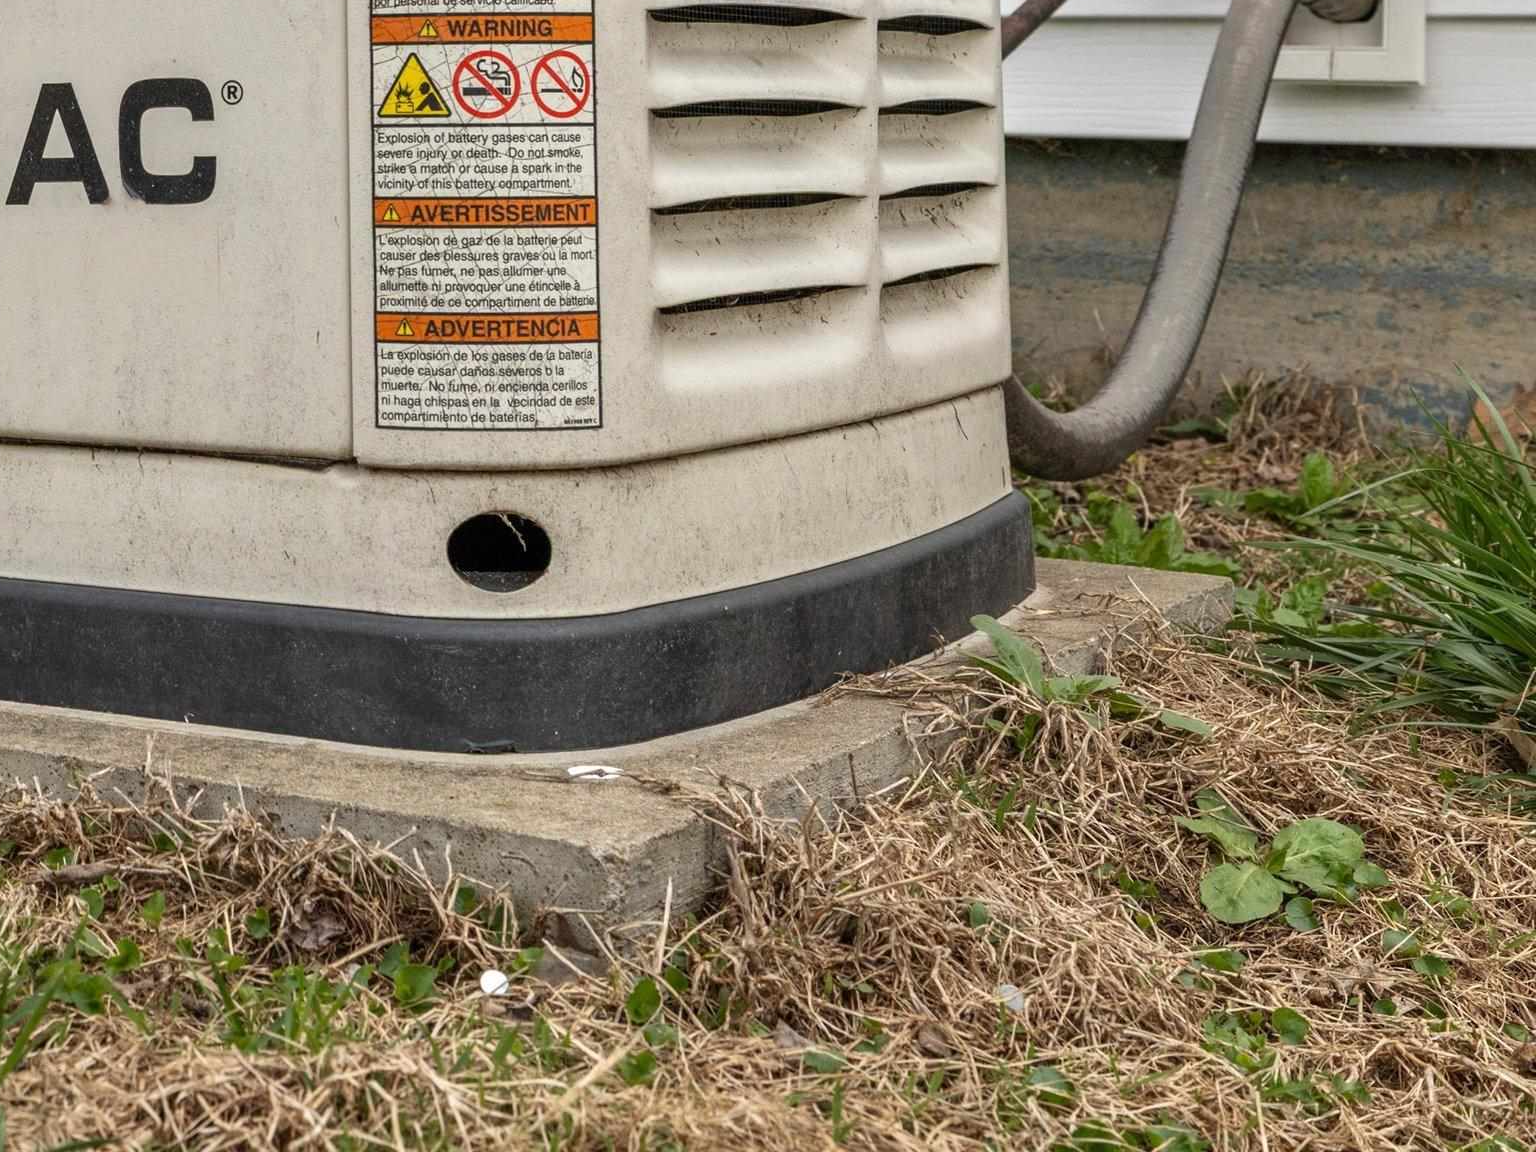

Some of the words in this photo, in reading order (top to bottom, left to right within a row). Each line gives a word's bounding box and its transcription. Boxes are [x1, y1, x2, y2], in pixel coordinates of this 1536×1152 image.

[374, 0, 391, 9] por
[447, 20, 553, 37] WARNING
[377, 133, 430, 145] Explosion
[434, 132, 445, 142] of
[448, 133, 488, 145] battery
[492, 134, 525, 145] gases
[529, 134, 548, 142] can
[551, 134, 580, 142] cause
[377, 150, 413, 158] severe
[452, 150, 462, 158] or
[508, 148, 523, 158] Do
[528, 149, 545, 158] not
[378, 164, 406, 174] strike
[421, 163, 455, 173] match
[459, 165, 470, 173] or
[474, 165, 508, 173] cause
[522, 163, 551, 175] spark
[567, 163, 582, 173] the
[377, 179, 414, 190] vicinity
[418, 179, 429, 189] of
[432, 179, 452, 189] this
[456, 179, 494, 190] battery
[411, 204, 590, 221] AVERTISSEMENT
[443, 236, 457, 245] de
[461, 236, 482, 248] gaz
[486, 236, 500, 245] de
[517, 235, 557, 245] batterie
[561, 235, 582, 247] peut
[380, 251, 416, 261] causer
[419, 251, 440, 261] des
[444, 250, 499, 260] blessures
[503, 251, 539, 263] graves
[543, 252, 555, 260] ou
[380, 267, 394, 276] Ne
[398, 268, 417, 278] pas
[479, 267, 499, 277] pas
[503, 267, 543, 275] allumer
[547, 267, 566, 275] une
[380, 281, 428, 291] allumette
[445, 282, 501, 293] provoquer
[505, 282, 525, 291] une
[432, 296, 444, 305] de
[447, 298, 461, 306] ce
[465, 296, 540, 308] compartiment
[544, 297, 557, 306] de
[425, 320, 580, 337] ADVERTENCIA
[381, 350, 393, 359] La
[454, 351, 467, 361] de
[472, 350, 488, 361] los
[492, 352, 525, 363] gases
[529, 350, 542, 361] de
[381, 366, 414, 377] puede
[418, 366, 455, 375] causar
[498, 367, 541, 376] severos
[429, 382, 444, 391] No
[498, 382, 549, 391] encienda
[394, 397, 421, 409] haga
[424, 397, 468, 409] chispas
[472, 398, 486, 407] en
[508, 397, 556, 407] vecindad
[560, 397, 571, 406] de
[575, 397, 595, 406] este
[381, 412, 467, 424] compartimiento
[471, 412, 485, 422] de
